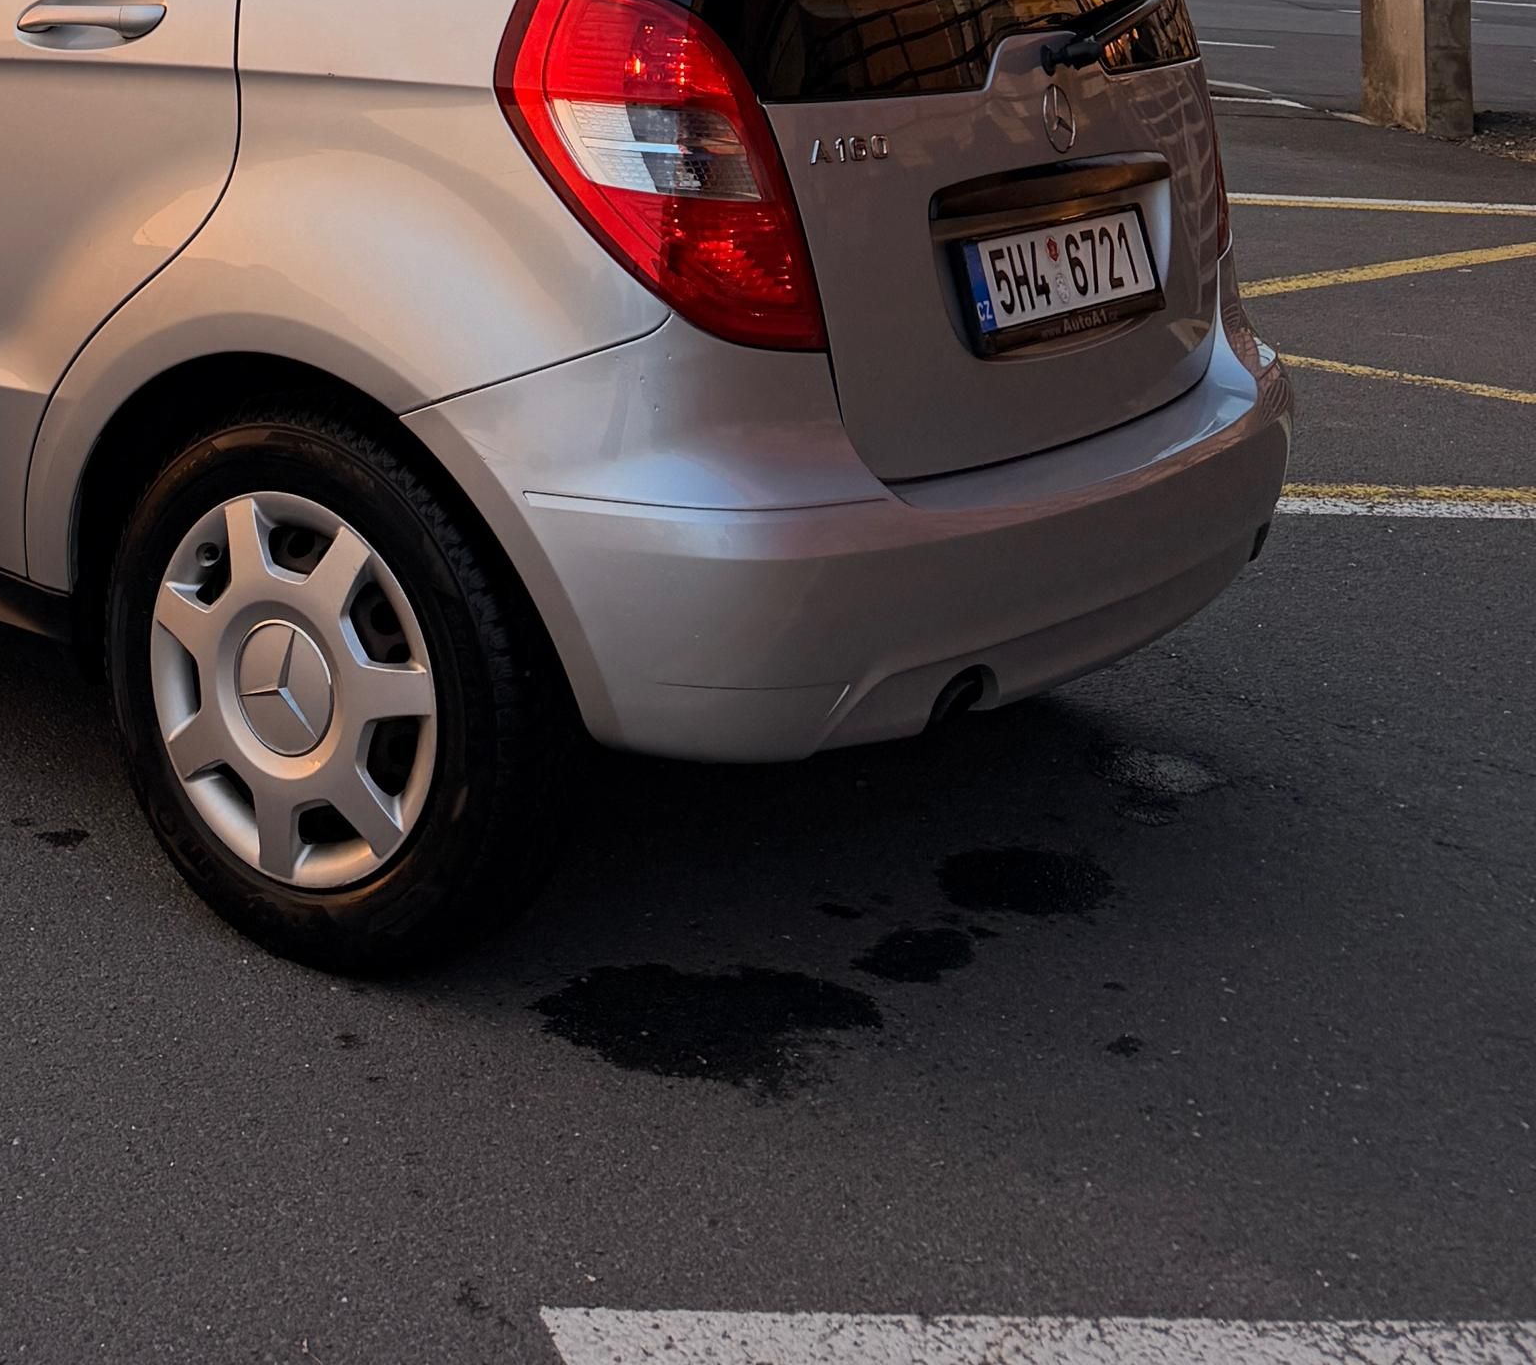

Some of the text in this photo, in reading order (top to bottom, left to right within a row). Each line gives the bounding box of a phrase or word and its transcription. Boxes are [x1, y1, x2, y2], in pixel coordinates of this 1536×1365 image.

[810, 135, 888, 165] A160
[988, 222, 1140, 315] 5H4 6721
[976, 300, 994, 322] CZ
